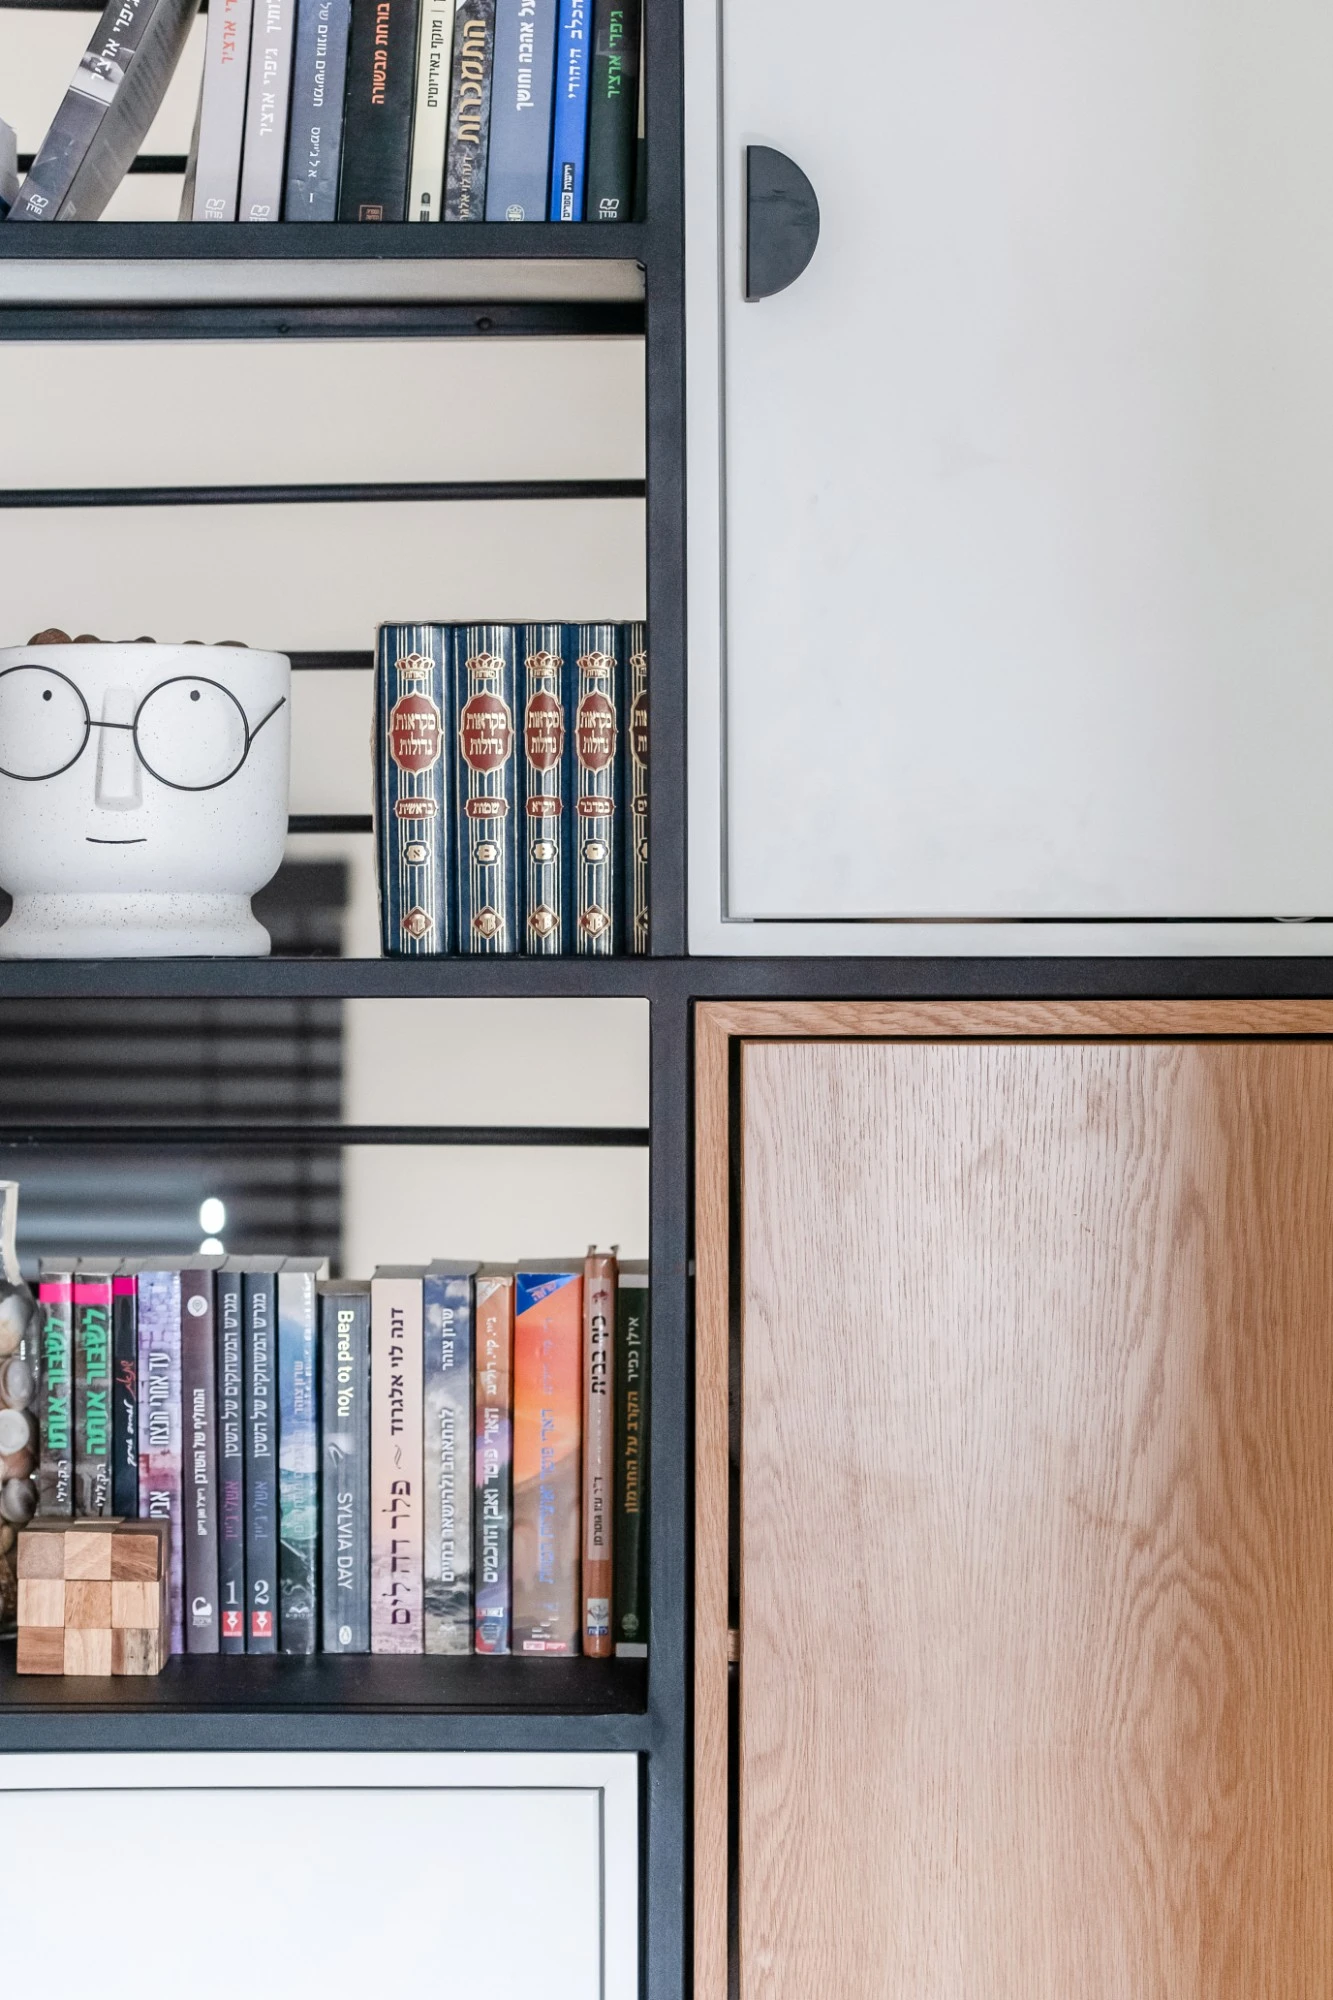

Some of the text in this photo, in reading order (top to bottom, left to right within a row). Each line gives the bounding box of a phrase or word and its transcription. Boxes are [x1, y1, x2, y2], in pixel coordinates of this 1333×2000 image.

[316, 24, 329, 56] גוונים
[371, 4, 390, 105] בורחת מבשורה
[519, 22, 534, 63] אהבה
[427, 20, 444, 108] מוקף באידיוטים
[457, 20, 486, 143] התמכרות
[567, 48, 582, 98] היהודי
[312, 60, 325, 107] חמישים
[516, 68, 534, 111] וחושך
[395, 713, 436, 736] מקראות
[466, 711, 506, 734] מקראות
[529, 711, 559, 734] מקראות
[531, 730, 556, 753] גדולות
[580, 711, 611, 734] מקראות
[399, 731, 432, 755] גדולות
[469, 731, 503, 756] גדולות
[583, 730, 608, 754] גדולות
[224, 1293, 238, 1329] מגרש
[252, 1293, 266, 1329] מגרש
[442, 1308, 457, 1371] שרון צוהר
[591, 1315, 609, 1395] כיף בבית
[626, 1317, 641, 1382] אילן כפיר
[150, 1352, 170, 1371] עד
[224, 1332, 241, 1396] המשחקים
[253, 1332, 269, 1396] המשחקים
[336, 1310, 354, 1417] Bared to You
[388, 1307, 404, 1436] דנה לוי אלגרוד
[44, 1318, 68, 1449] לשבור אותו
[81, 1309, 107, 1455] לשבור אותה
[150, 1376, 169, 1406] אחרי
[150, 1411, 170, 1445] הנצח
[193, 1389, 208, 1429] המחליף
[222, 1400, 238, 1420] של
[250, 1400, 266, 1420] של
[192, 1432, 206, 1448] של
[224, 1422, 241, 1458] השטן
[253, 1422, 270, 1458] השטן
[624, 1391, 640, 1513] הקרב על החרמון
[382, 1480, 411, 1529] פלר
[439, 1408, 455, 1582] להתאהב ולהישאר בחיים
[483, 1407, 503, 1583] הארי פוטר ואבן החכמים
[336, 1492, 353, 1590] SYLVIA DAY
[391, 1539, 411, 1573] דה
[226, 1580, 239, 1604] 1
[254, 1579, 270, 1605] 2
